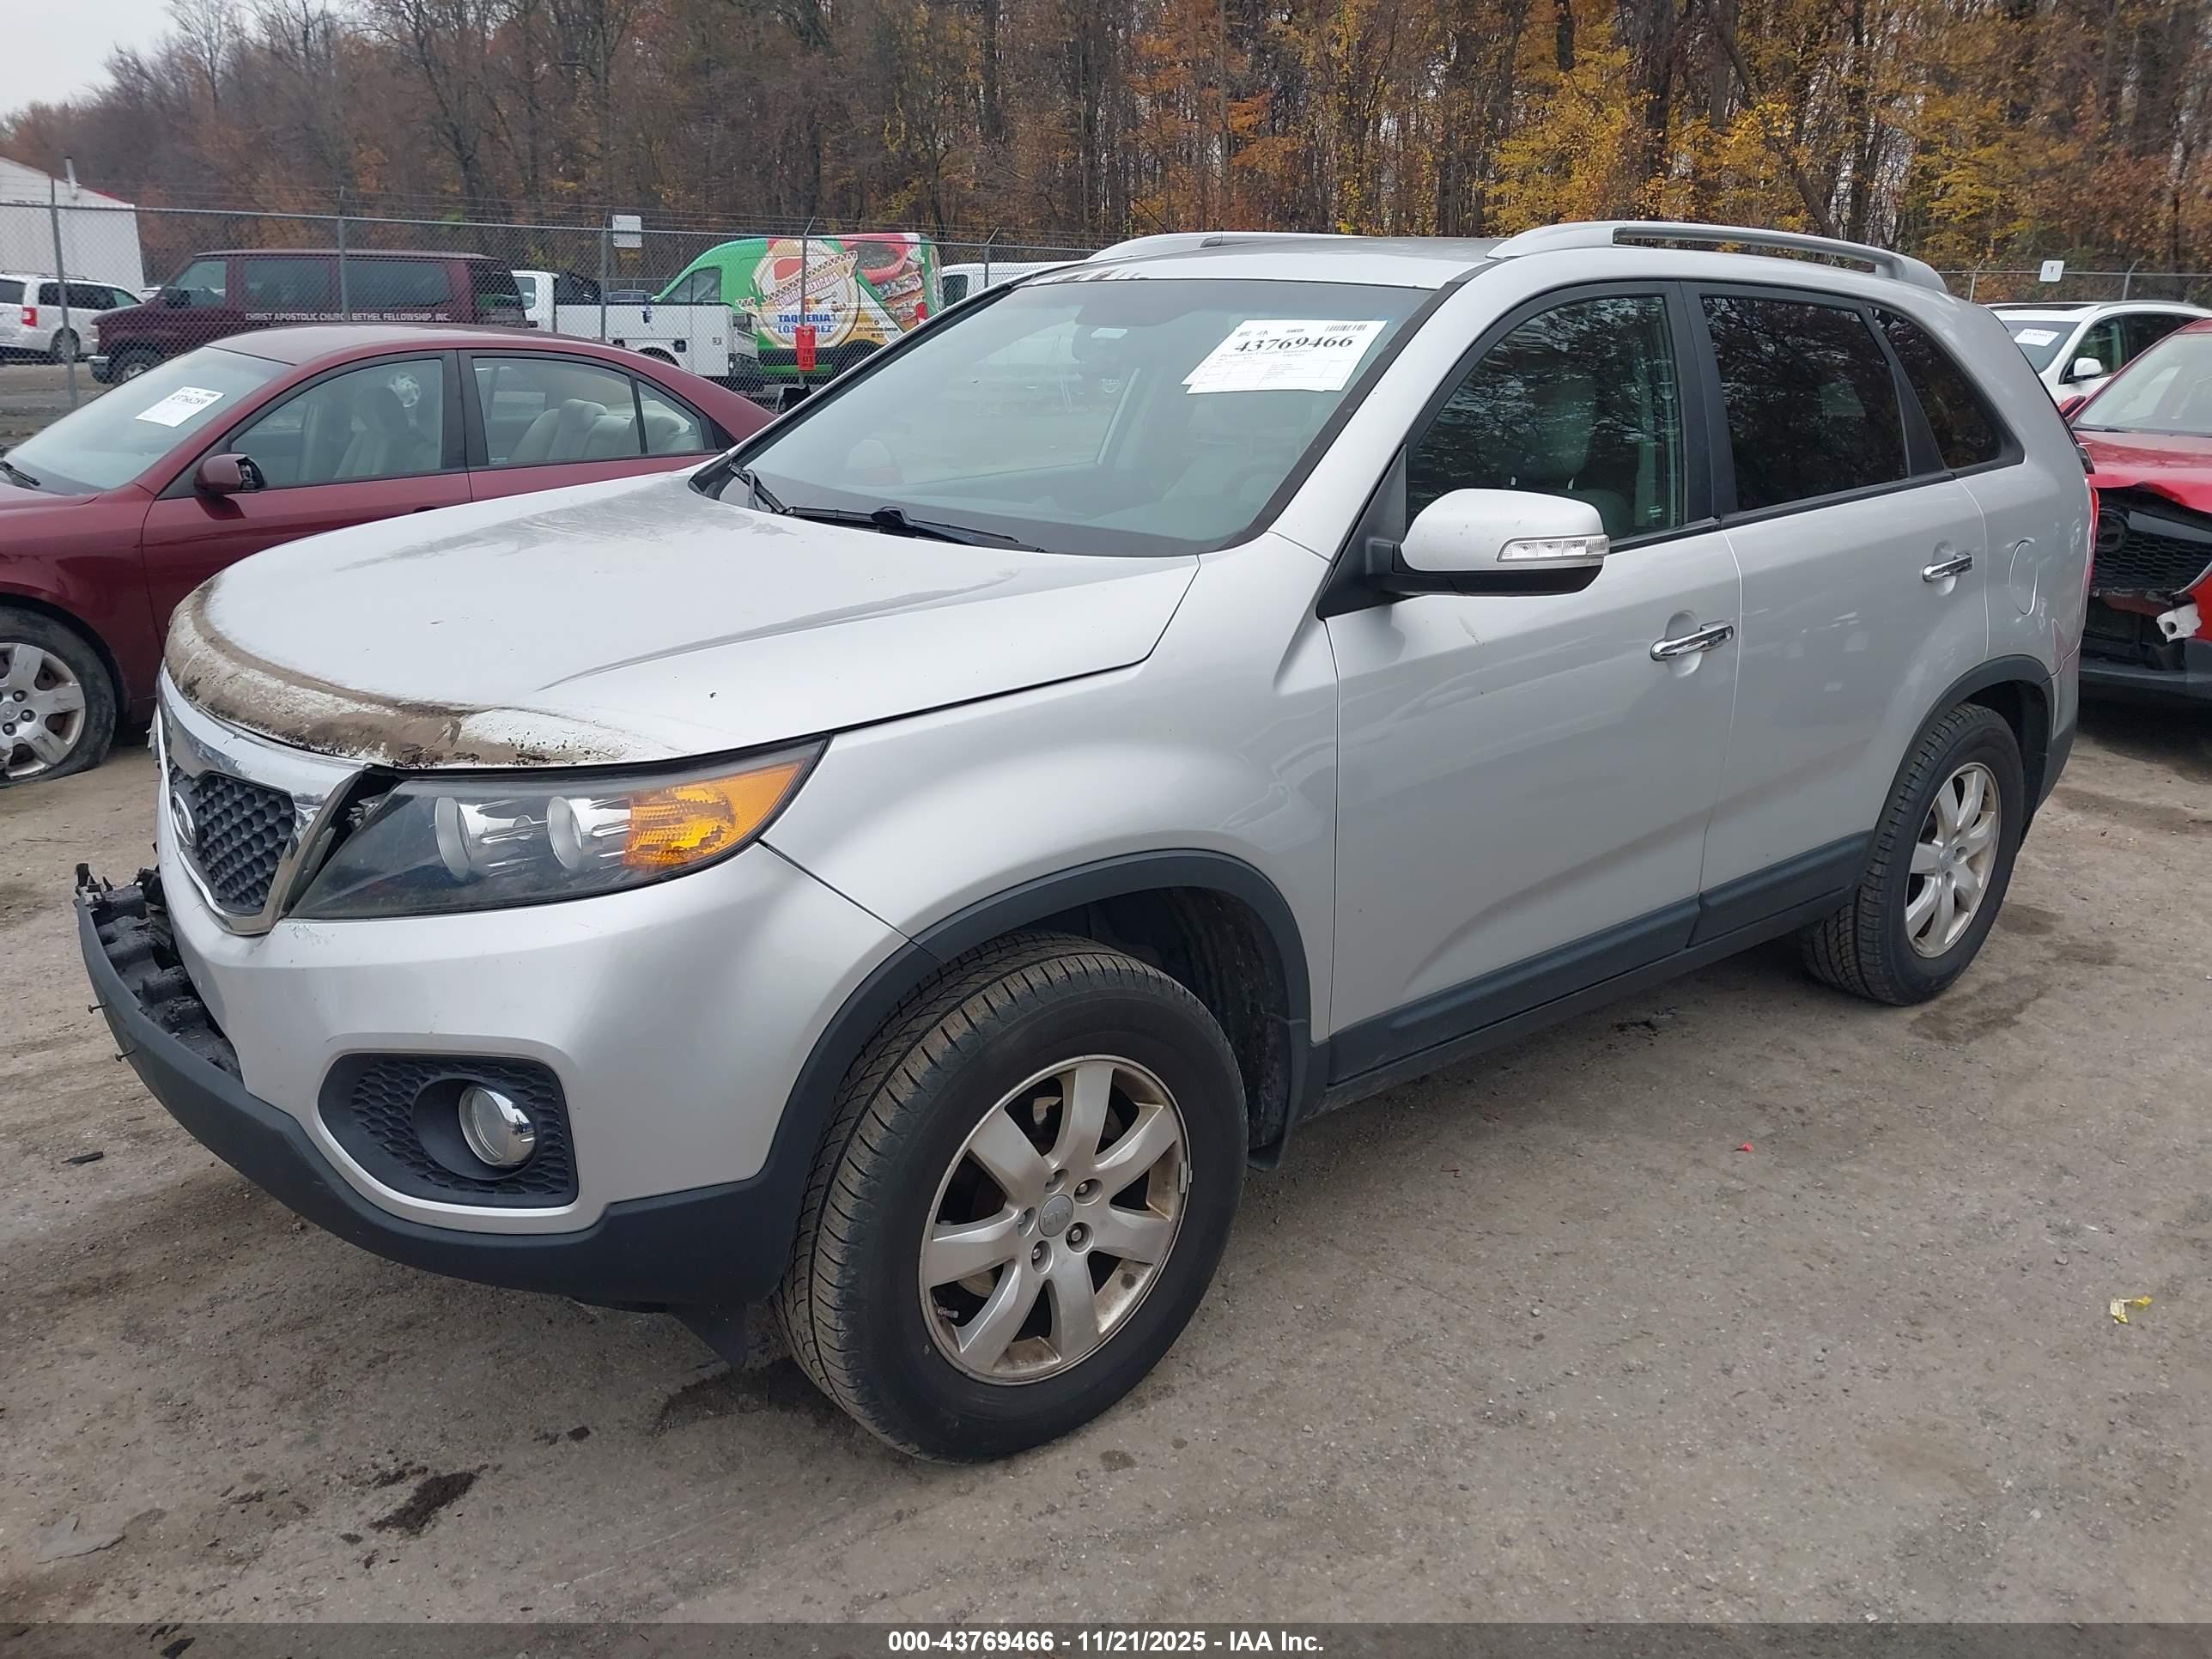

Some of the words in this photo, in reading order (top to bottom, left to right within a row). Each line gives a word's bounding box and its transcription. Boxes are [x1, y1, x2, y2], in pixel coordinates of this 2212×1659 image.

[246, 313, 273, 321] CHRIST
[274, 313, 318, 321] APOSTOLIC
[351, 313, 381, 321] BETHEL
[1234, 335, 1356, 352] 43769466
